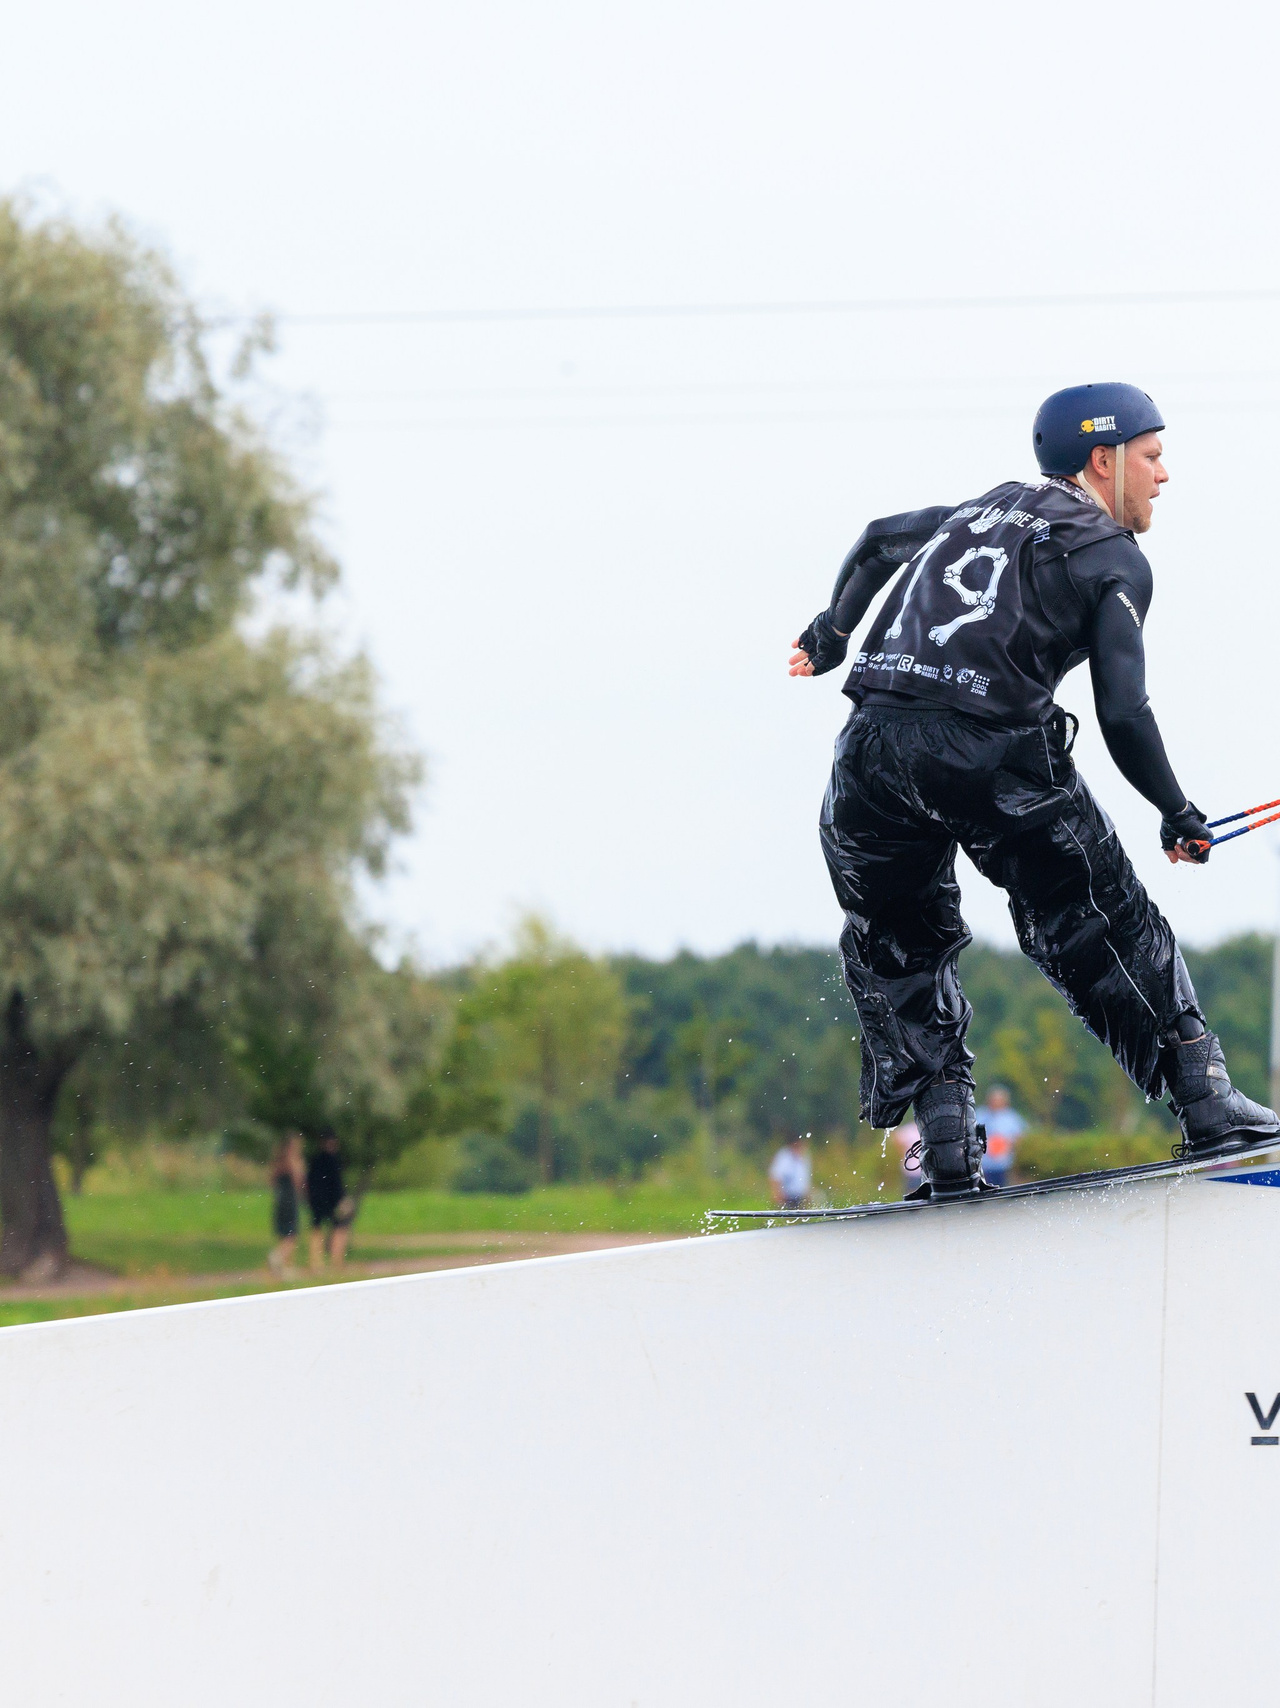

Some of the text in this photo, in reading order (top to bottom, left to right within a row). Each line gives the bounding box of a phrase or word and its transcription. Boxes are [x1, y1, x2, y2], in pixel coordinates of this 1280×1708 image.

[1093, 416, 1115, 425] DIRTY
[1095, 424, 1116, 432] HABITS
[884, 532, 1009, 646] 19
[922, 664, 940, 674] DIRTY
[972, 682, 988, 691] COOL
[970, 688, 987, 697] ZONE
